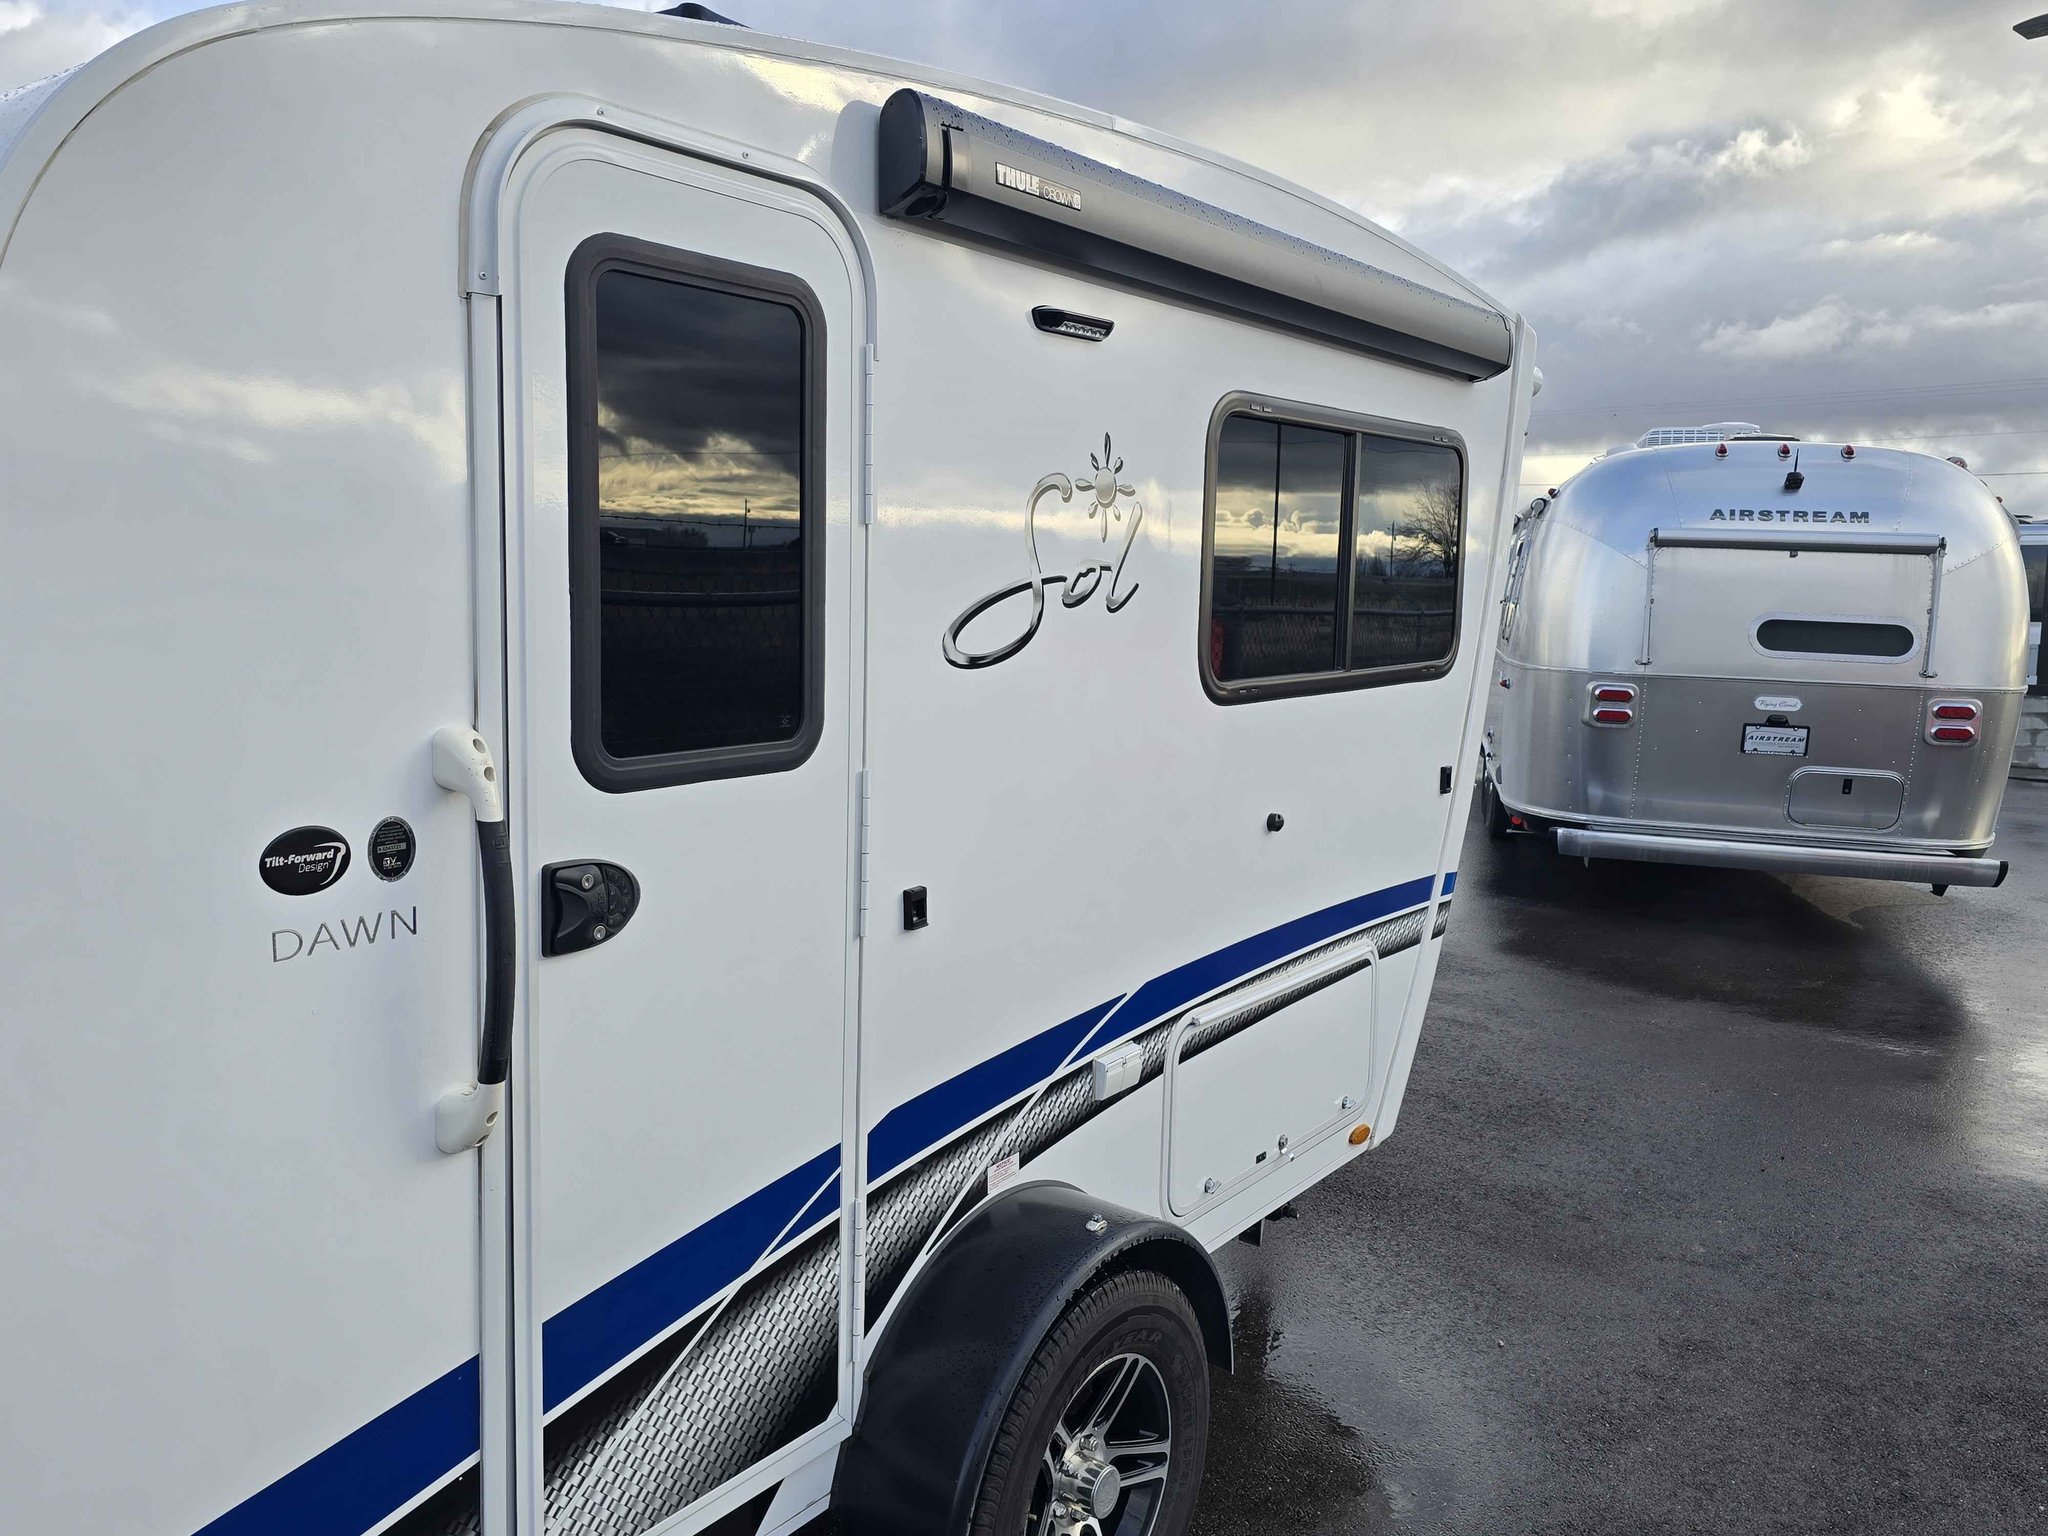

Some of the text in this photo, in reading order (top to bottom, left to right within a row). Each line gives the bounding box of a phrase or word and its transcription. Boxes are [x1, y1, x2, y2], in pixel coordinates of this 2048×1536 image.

[997, 163, 1040, 195] THULE
[1709, 508, 1870, 524] AIRSTREAM
[942, 472, 1143, 669] Sol
[1778, 700, 1799, 709] Cloud
[1748, 735, 1806, 743] AIRSTREAM
[264, 848, 335, 868] Tilt-Forward
[298, 862, 329, 874] Design
[271, 905, 417, 963] DAWN
